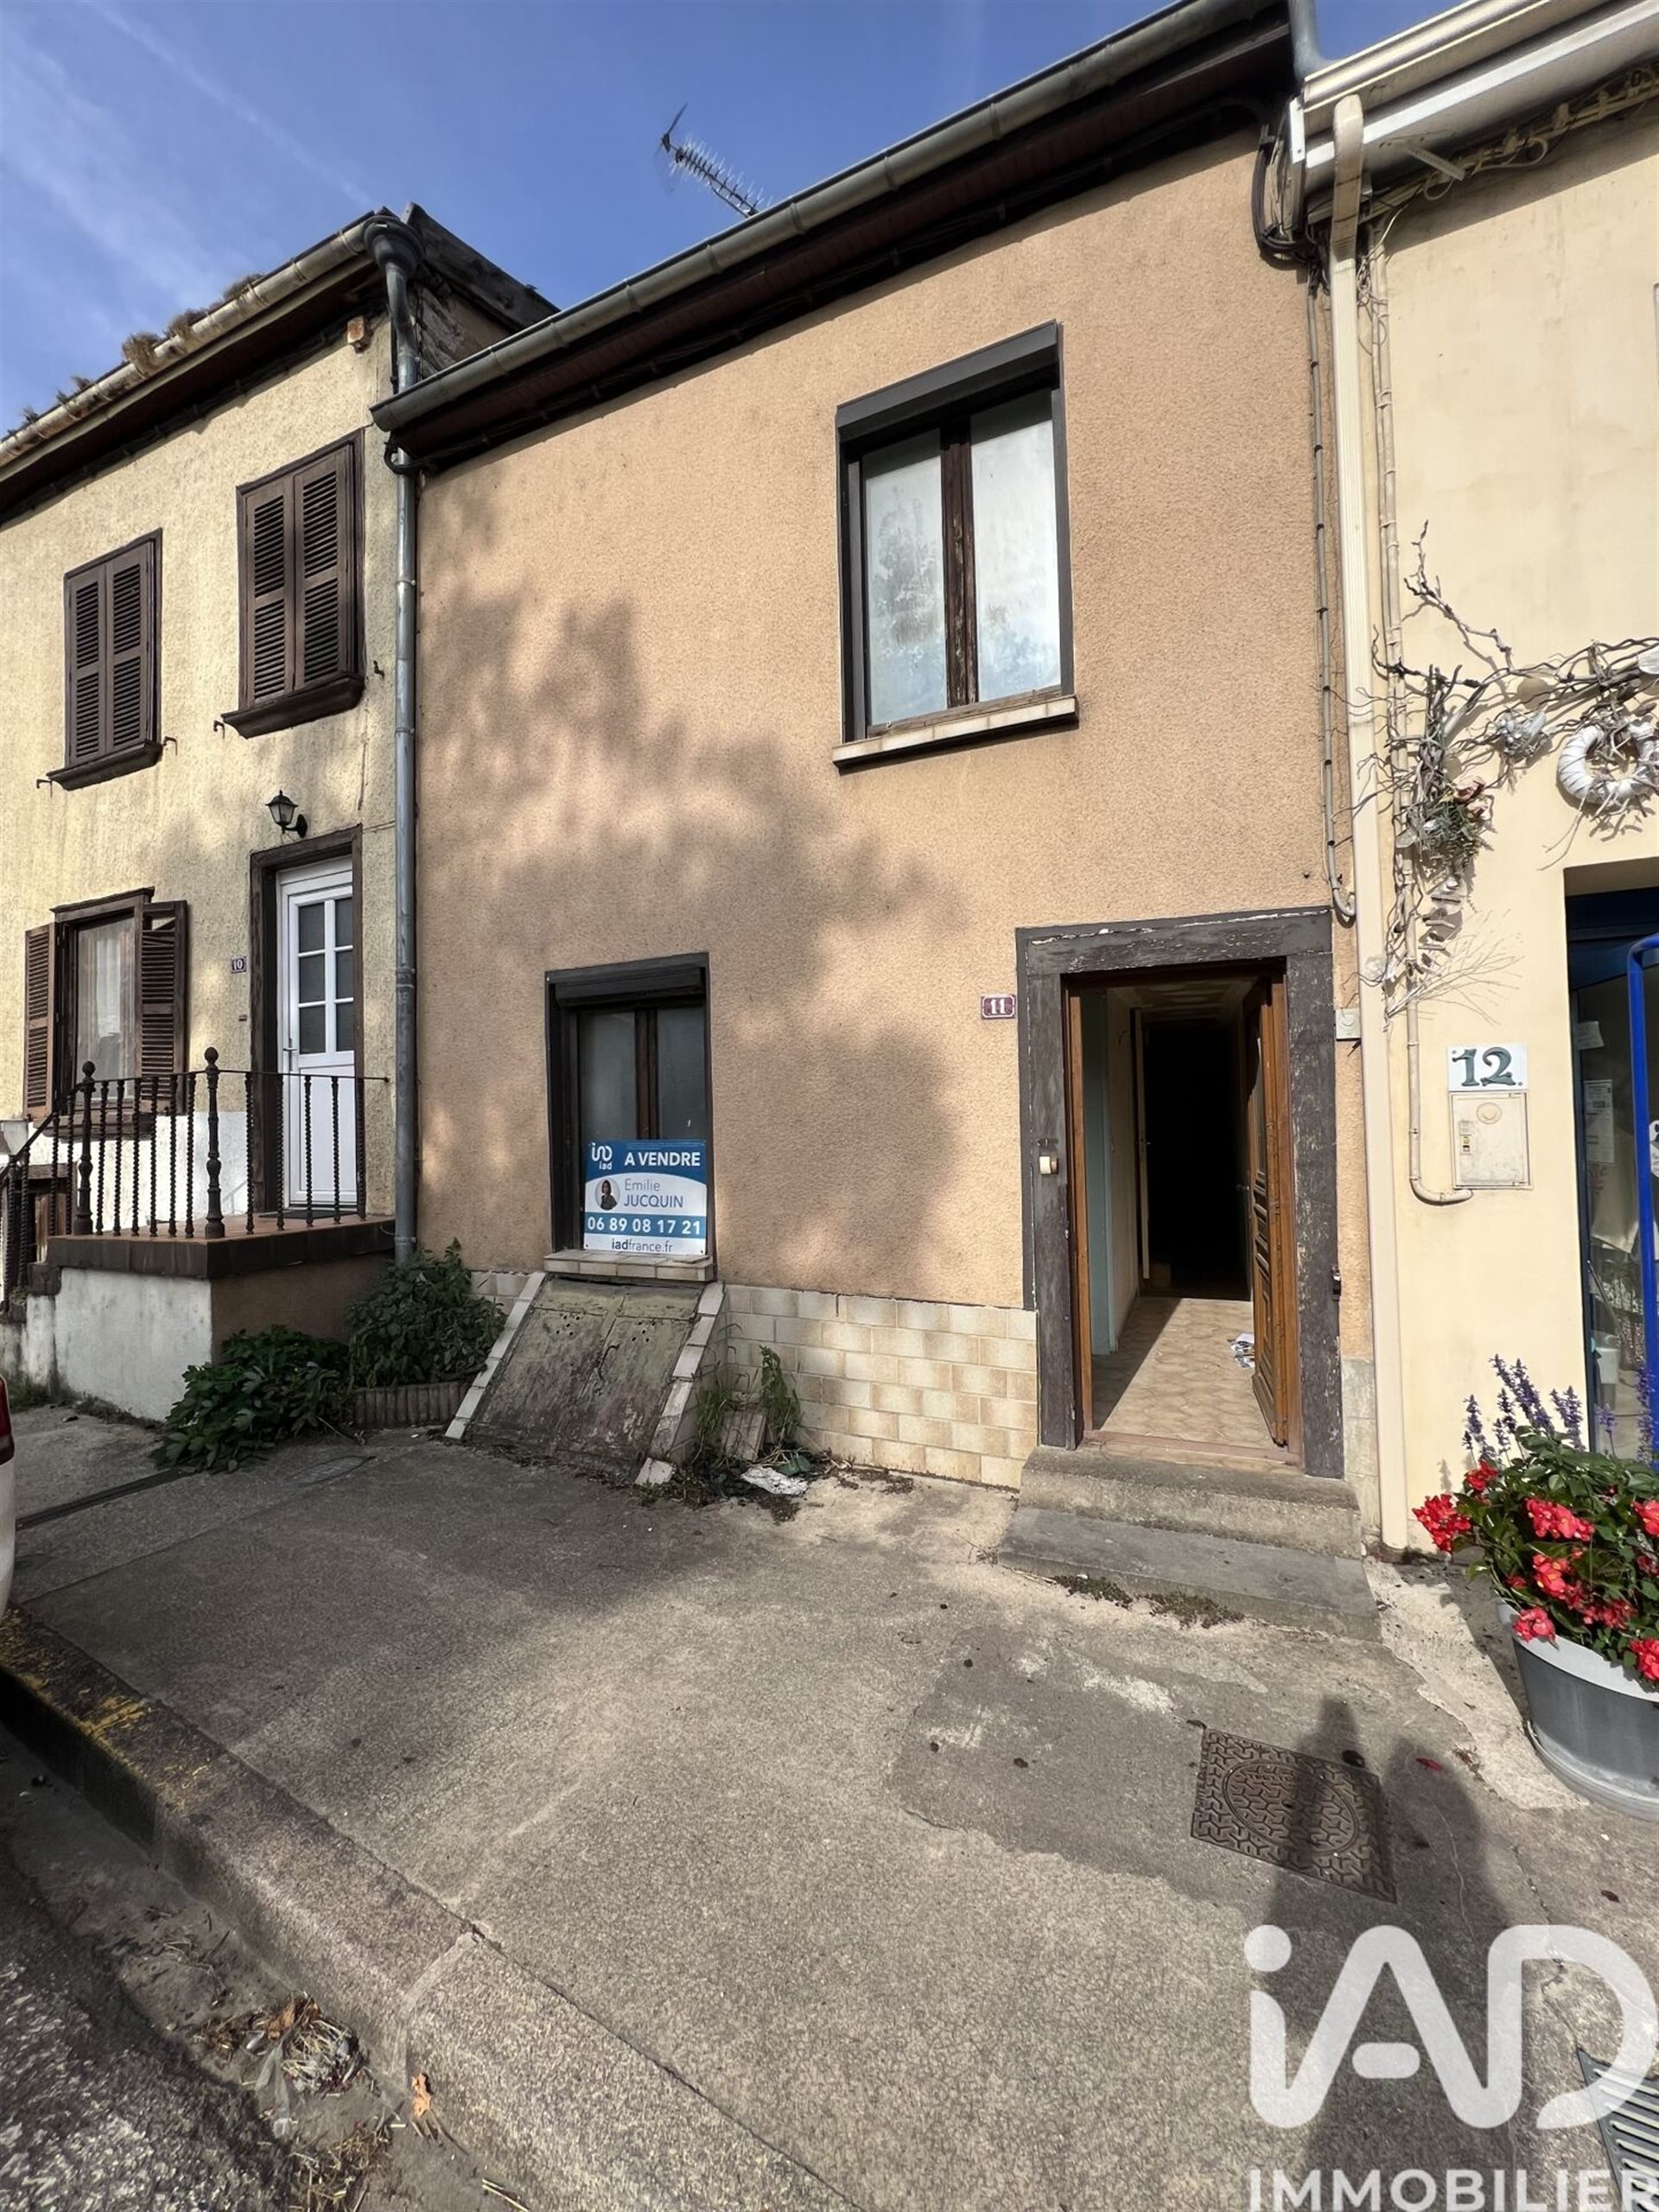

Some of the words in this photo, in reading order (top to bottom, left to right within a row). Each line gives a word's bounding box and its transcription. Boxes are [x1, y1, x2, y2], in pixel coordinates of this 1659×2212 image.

[233, 958, 243, 970] 10
[990, 998, 1007, 1014] 11
[1452, 1046, 1516, 1086] 12
[599, 1161, 613, 1170] iad
[624, 1152, 635, 1166] A
[638, 1152, 701, 1166] VENDRE
[624, 1179, 661, 1192] Emilie
[624, 1194, 684, 1208] JUCQUIN
[588, 1217, 605, 1230] 06
[609, 1217, 627, 1231] 89
[632, 1218, 651, 1233] 08
[658, 1219, 677, 1234] 17
[682, 1220, 701, 1235] 21
[611, 1238, 674, 1252] iadfrance.fr
